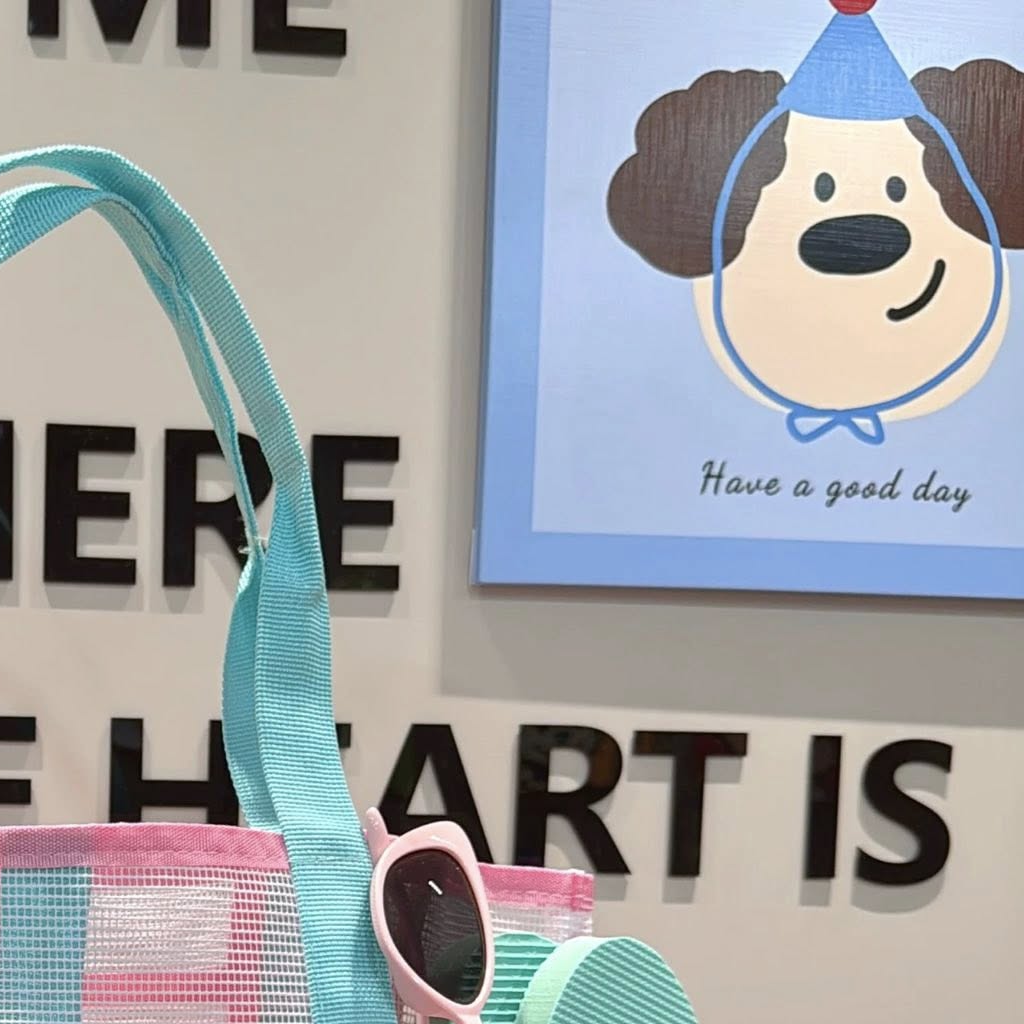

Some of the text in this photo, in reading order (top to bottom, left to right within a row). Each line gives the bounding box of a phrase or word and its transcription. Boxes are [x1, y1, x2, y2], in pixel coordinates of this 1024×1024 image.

[699, 460, 973, 513] Have a good day
[109, 717, 749, 878] HART
[803, 734, 954, 887] IS
